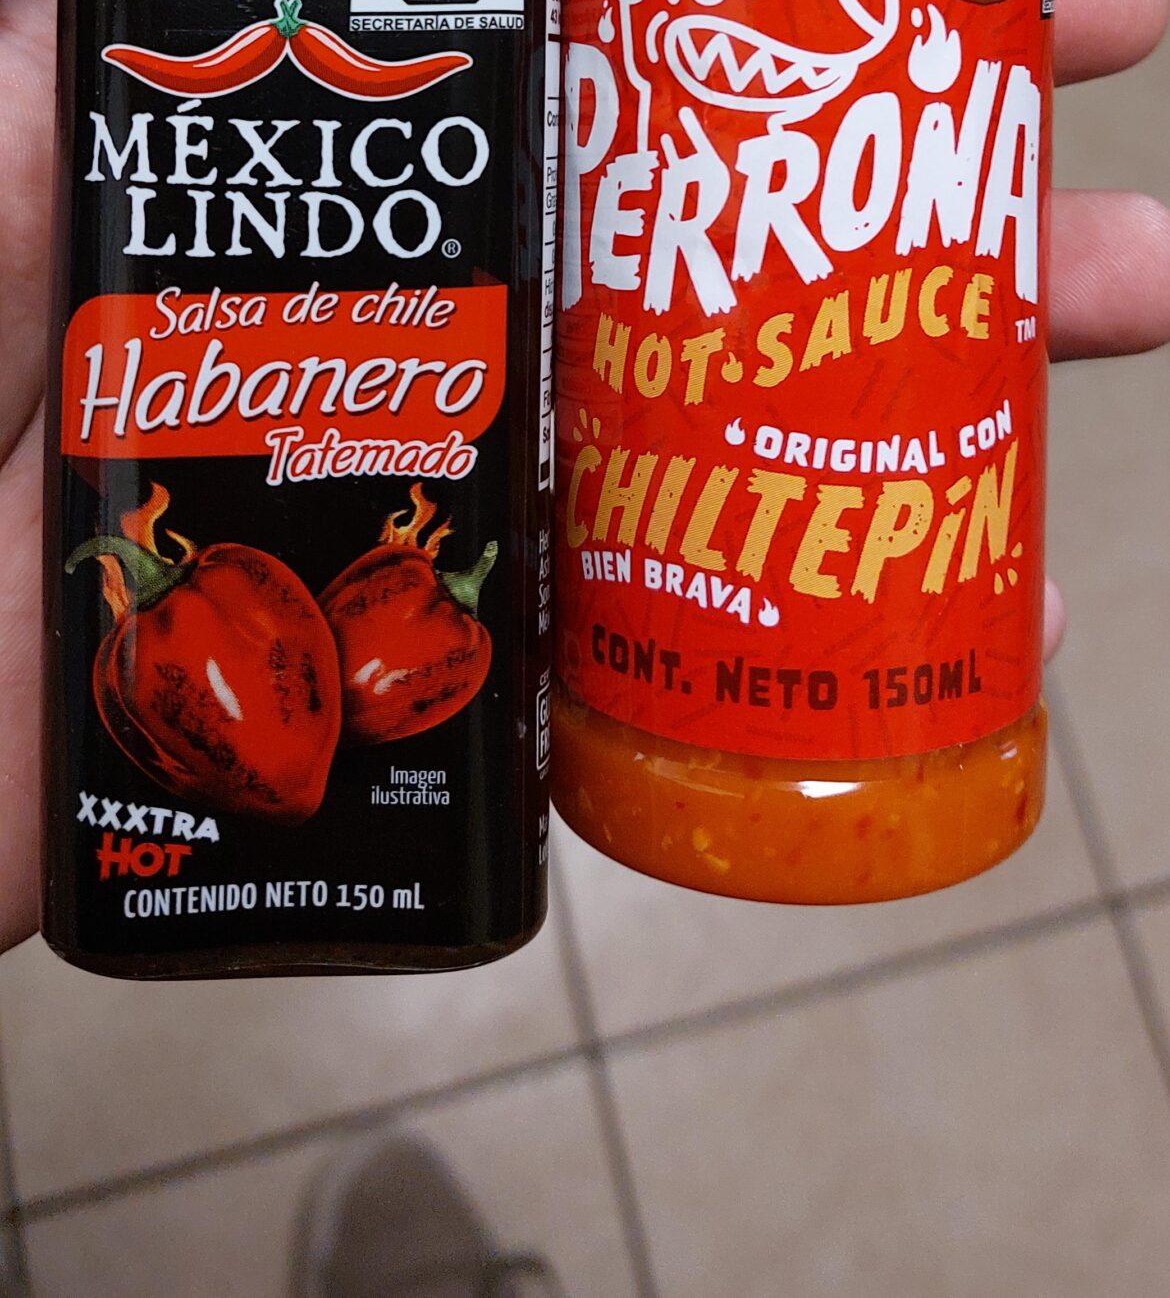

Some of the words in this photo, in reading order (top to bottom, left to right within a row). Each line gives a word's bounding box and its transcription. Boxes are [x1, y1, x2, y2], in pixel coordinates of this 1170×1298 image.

[454, 16, 474, 30] DE
[479, 16, 524, 29] SALUD
[84, 98, 490, 187] MÉXICO
[563, 42, 1040, 317] PERRONA
[150, 286, 267, 339] Salsa
[282, 280, 336, 324] de
[352, 282, 455, 328] chile
[592, 311, 727, 405] HOT
[752, 264, 995, 388] SAUCE
[80, 337, 489, 441] Habanero
[265, 426, 478, 486] Tatemado
[753, 424, 946, 474] ORIGINAL
[959, 399, 1012, 458] CON
[581, 549, 631, 583] BIEN
[644, 559, 751, 624] BRAVA
[591, 622, 692, 694] CONT.
[716, 656, 838, 711] NETO
[862, 648, 981, 710] 150ML
[371, 785, 451, 806] ilustrativa
[390, 765, 446, 788] Imagen
[76, 790, 220, 843] XXXTRA
[96, 832, 192, 882] HOT
[124, 882, 257, 918] CONTENIDO
[266, 880, 328, 908] NETO
[336, 884, 385, 911] 150
[393, 882, 425, 909] mL
